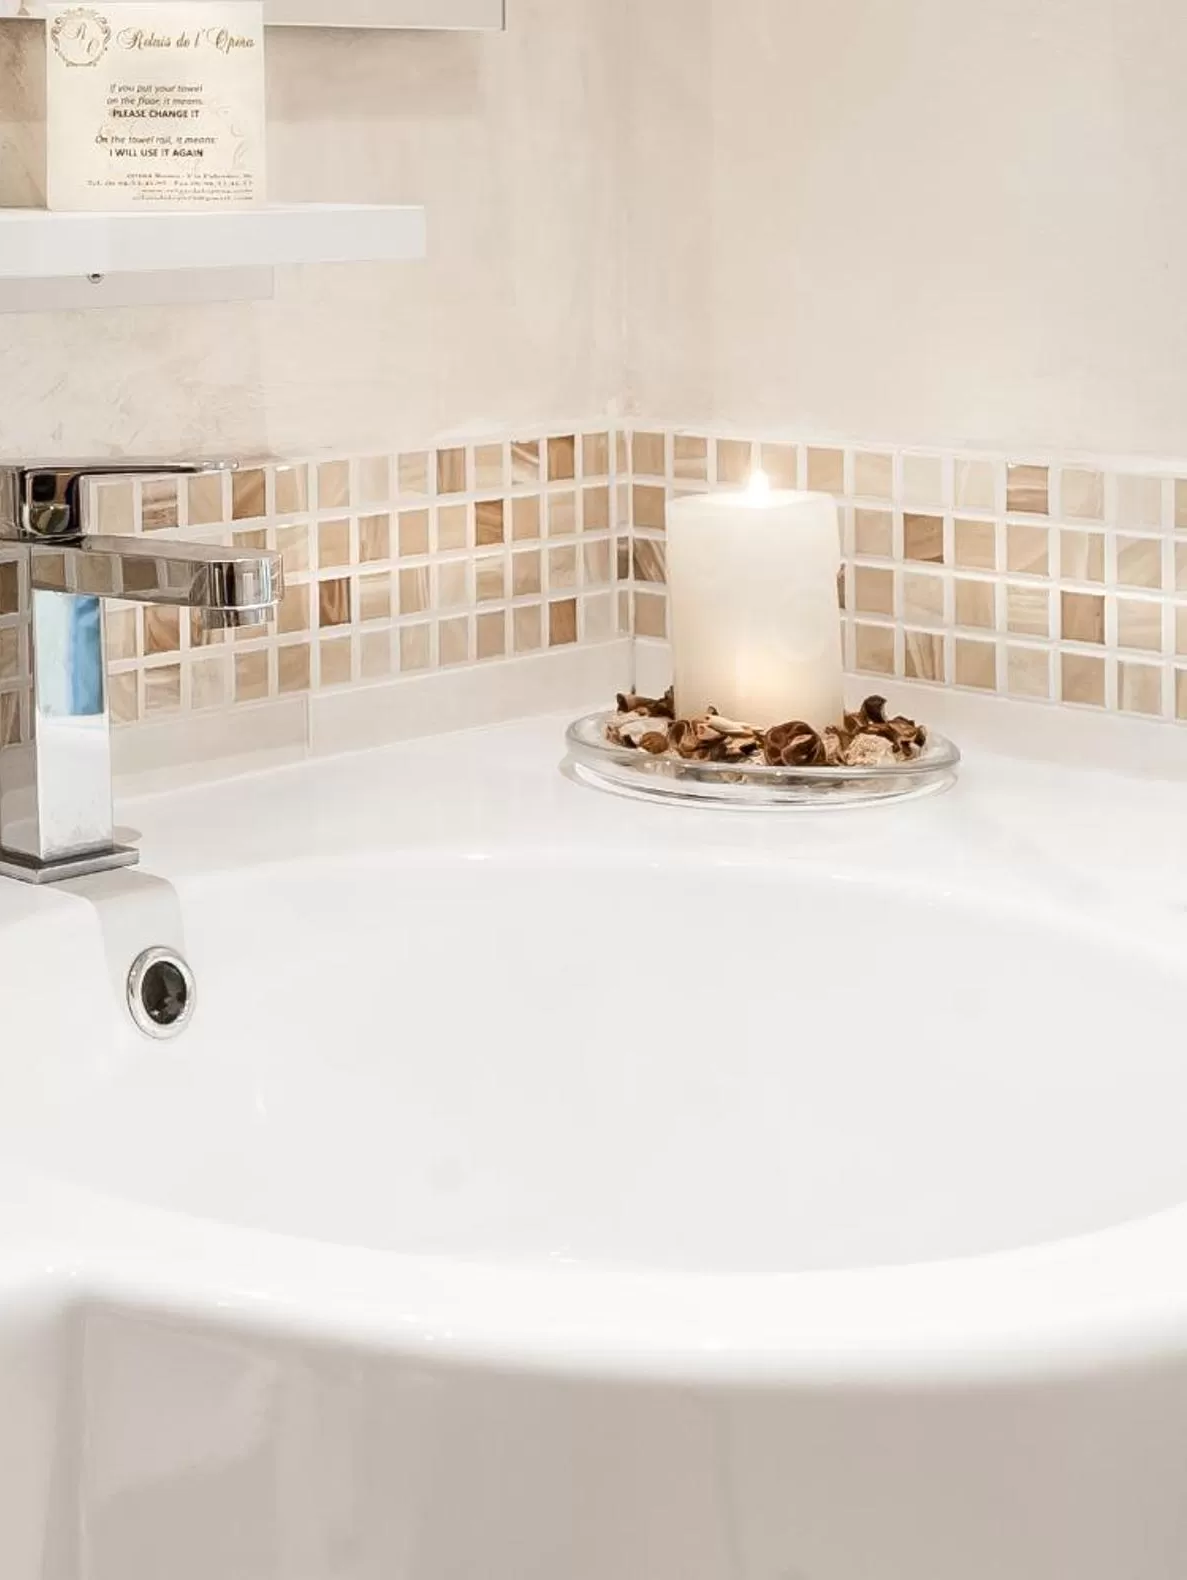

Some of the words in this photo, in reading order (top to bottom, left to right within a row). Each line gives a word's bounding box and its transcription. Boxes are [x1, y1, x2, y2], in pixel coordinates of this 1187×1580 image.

[117, 27, 171, 50] Relais
[176, 31, 190, 48] de
[137, 84, 153, 93] put
[155, 85, 175, 93] your
[178, 84, 203, 92] towel
[121, 96, 136, 104] the
[113, 109, 146, 118] PLEASE
[149, 109, 188, 118] CHANGE
[191, 109, 199, 118] IT
[95, 135, 108, 144] On
[111, 135, 126, 144] the
[129, 135, 154, 144] towel
[115, 149, 138, 157] WILL
[140, 149, 158, 157] USE
[161, 149, 170, 157] IT
[172, 149, 203, 157] AGAIN
